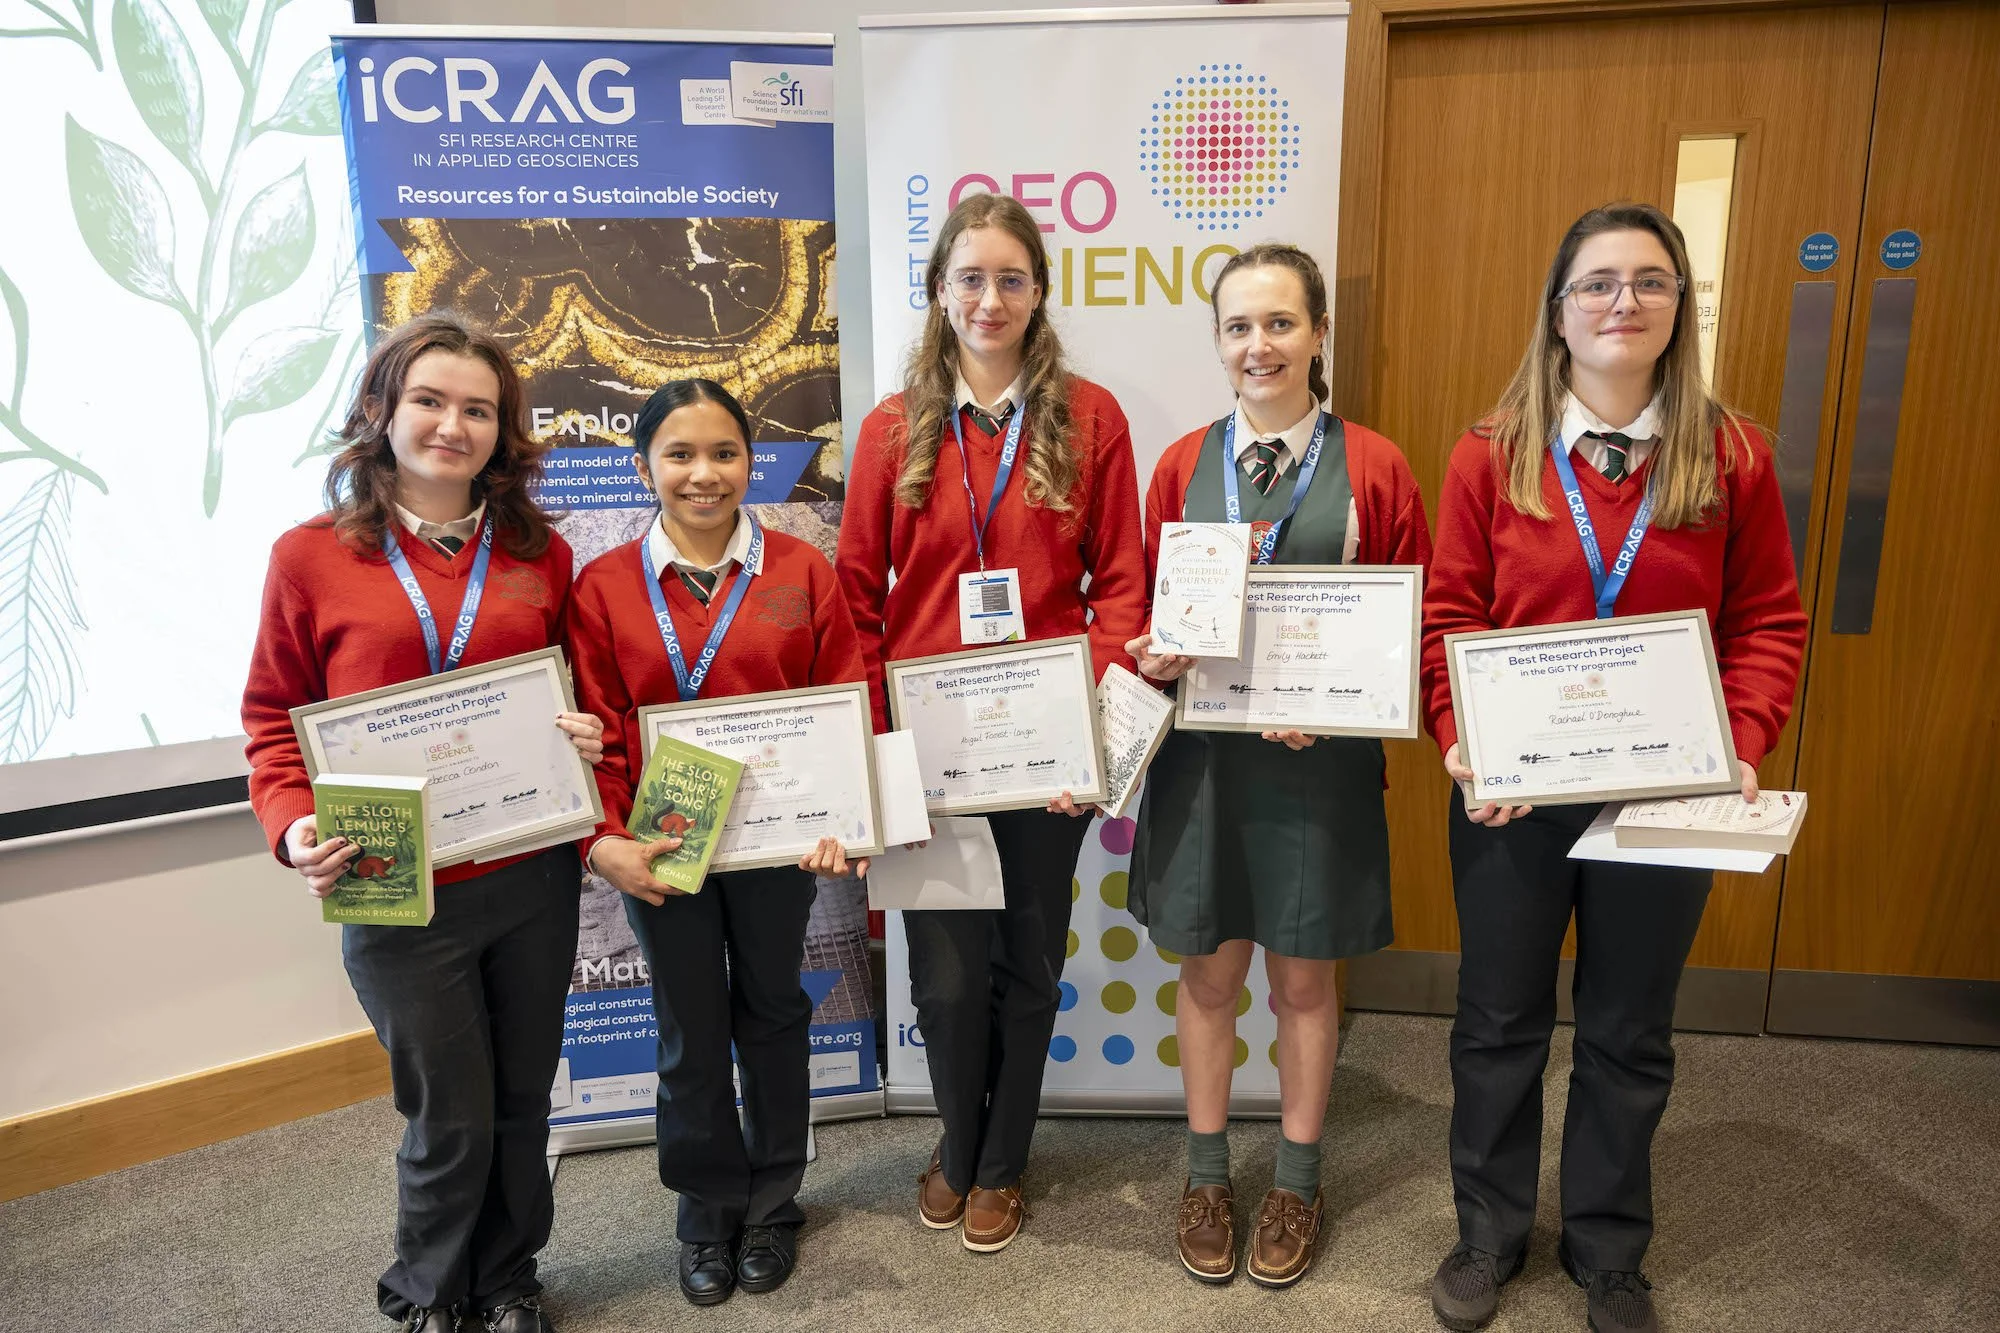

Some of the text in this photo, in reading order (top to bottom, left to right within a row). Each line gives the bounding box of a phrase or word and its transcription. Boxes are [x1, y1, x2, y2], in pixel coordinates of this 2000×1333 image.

[359, 56, 636, 125] iCRAG
[752, 90, 777, 98] Science
[742, 97, 777, 106] Foundation
[755, 105, 778, 113] Ireland
[439, 134, 638, 148] SFI RESEARCH CENTRE
[413, 153, 640, 168] IN APPLIED GEOSCIENCES
[397, 186, 780, 209] Resources for a Sustainable Society
[907, 174, 929, 311] GET INTO
[1807, 243, 1819, 251] Fire
[1804, 253, 1818, 261] keep
[1886, 250, 1915, 259] keep shut
[1001, 426, 1020, 467] iCRAG
[1305, 428, 1324, 467] iCRAG
[542, 457, 569, 469] ural
[571, 456, 612, 468] model
[614, 456, 629, 466] of
[591, 475, 640, 486] vectors
[566, 491, 632, 504] to mineral
[1566, 489, 1593, 537] iCRAG
[742, 537, 762, 578] iCRAG
[1612, 527, 1644, 577] iCRAG
[1250, 582, 1294, 590] Certificate
[1296, 582, 1307, 590] for
[1342, 582, 1351, 590] of
[400, 576, 431, 619] iCRAG
[1266, 592, 1361, 605] Research Project
[1271, 605, 1287, 613] GiG
[1288, 605, 1300, 613] TY
[1301, 607, 1352, 616] programme
[447, 614, 474, 663] iCRAG
[656, 610, 681, 655] iCRAG
[1280, 632, 1319, 640] SCIENCE
[1518, 641, 1568, 653] Certificate
[1585, 635, 1619, 646] winner
[1620, 634, 1630, 642] of
[1508, 643, 1646, 666] Best Research Project
[687, 647, 716, 693] iCRAG
[943, 665, 981, 677] Certificate
[994, 660, 1020, 669] winner
[1520, 659, 1637, 677] in the GiG TY programme
[936, 668, 1041, 689] Best Research Project
[945, 692, 952, 700] in
[965, 688, 979, 697] GiG
[980, 687, 990, 695] TY
[991, 682, 1035, 694] programme
[1563, 684, 1584, 693] GEO
[1564, 689, 1609, 701] SCIENCE
[376, 682, 493, 716] Certificate for winner of
[1193, 701, 1227, 710] iCRAG
[366, 691, 508, 733] Best Research Project
[705, 711, 749, 723] Certificate
[749, 710, 762, 718] for
[764, 707, 792, 716] winner
[978, 711, 1011, 721] SCIENCE
[1113, 701, 1138, 724] Secret
[381, 708, 501, 743] in the GiG TY programme
[696, 715, 815, 736] Best Research Project
[1105, 708, 1137, 736] Network
[714, 739, 728, 747] the
[729, 737, 745, 745] GiG
[746, 735, 757, 743] TY
[758, 730, 808, 743] programme
[1101, 726, 1126, 749] Nature
[428, 742, 451, 754] GEO
[430, 744, 475, 762] SCIENCE
[660, 755, 686, 773] THE
[687, 765, 729, 788] SLOTH
[743, 760, 781, 771] SCIENCE
[661, 772, 718, 800] LEMUR'S
[1483, 774, 1522, 786] iCRAG
[664, 788, 704, 811] SONG
[326, 804, 413, 818] THE SLOTH
[335, 820, 407, 833] LEMUR'S
[348, 835, 397, 848] SONG
[656, 864, 693, 884] RICHARD
[333, 908, 418, 918] ALISON RICHARD
[577, 1030, 632, 1045] footprint
[634, 1028, 647, 1038] of
[629, 1087, 652, 1096] DIAS
